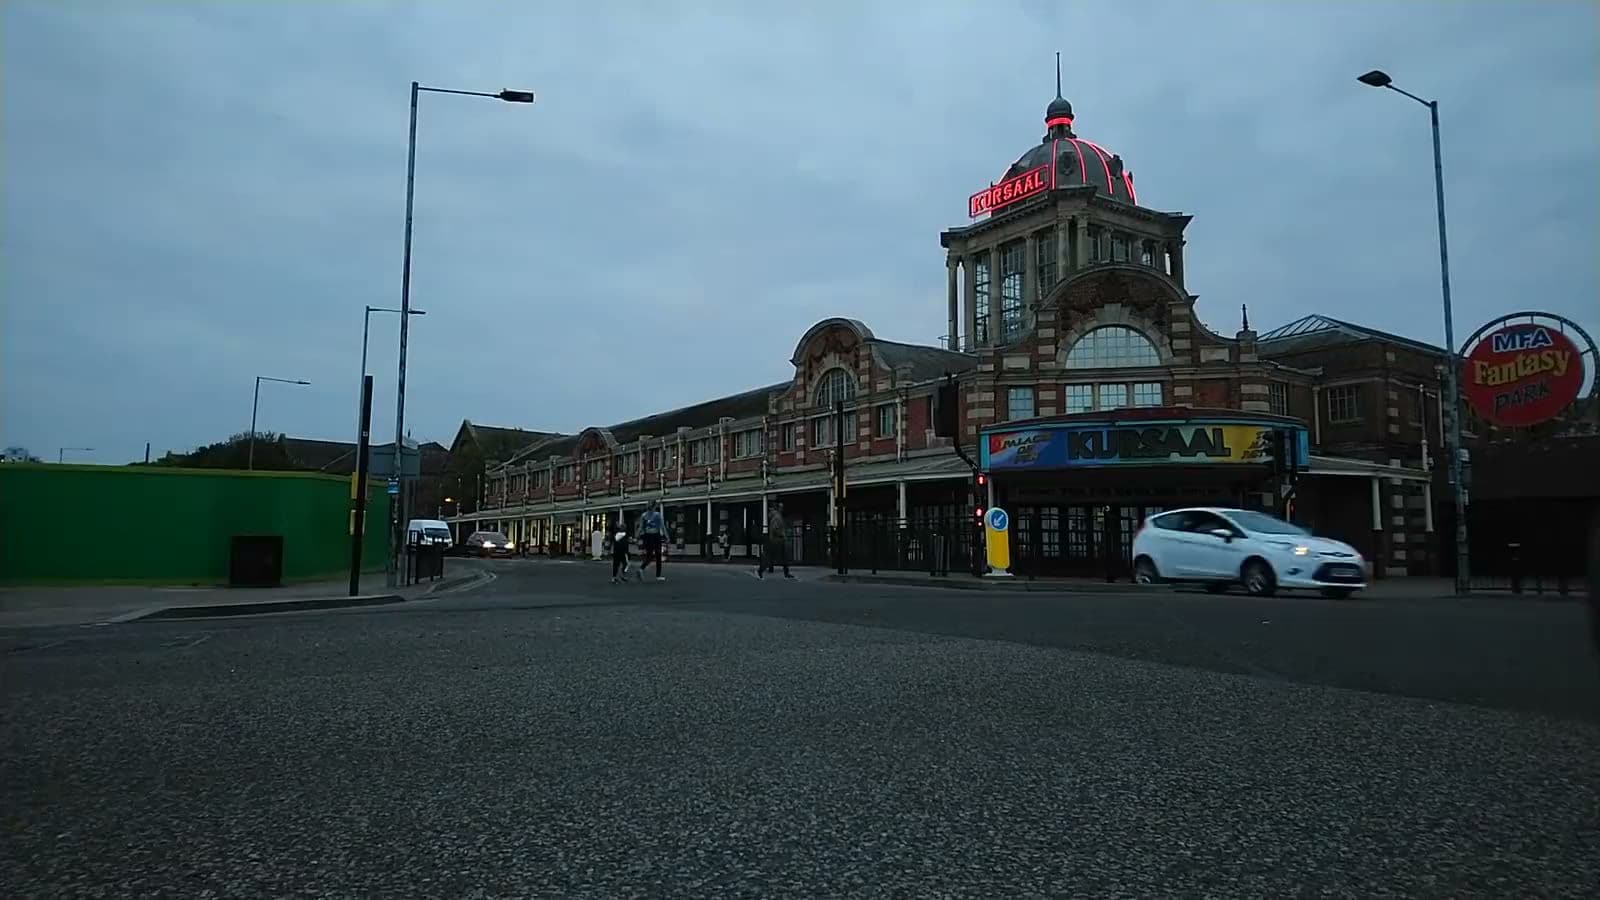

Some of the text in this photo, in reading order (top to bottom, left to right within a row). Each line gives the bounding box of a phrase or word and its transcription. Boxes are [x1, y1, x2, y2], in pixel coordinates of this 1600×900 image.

[972, 172, 1043, 213] KURSAAL
[1493, 329, 1553, 352] MFA
[1473, 350, 1570, 385] Fantasy
[1494, 380, 1550, 412] PARK
[1068, 427, 1231, 460] KURSAAL
